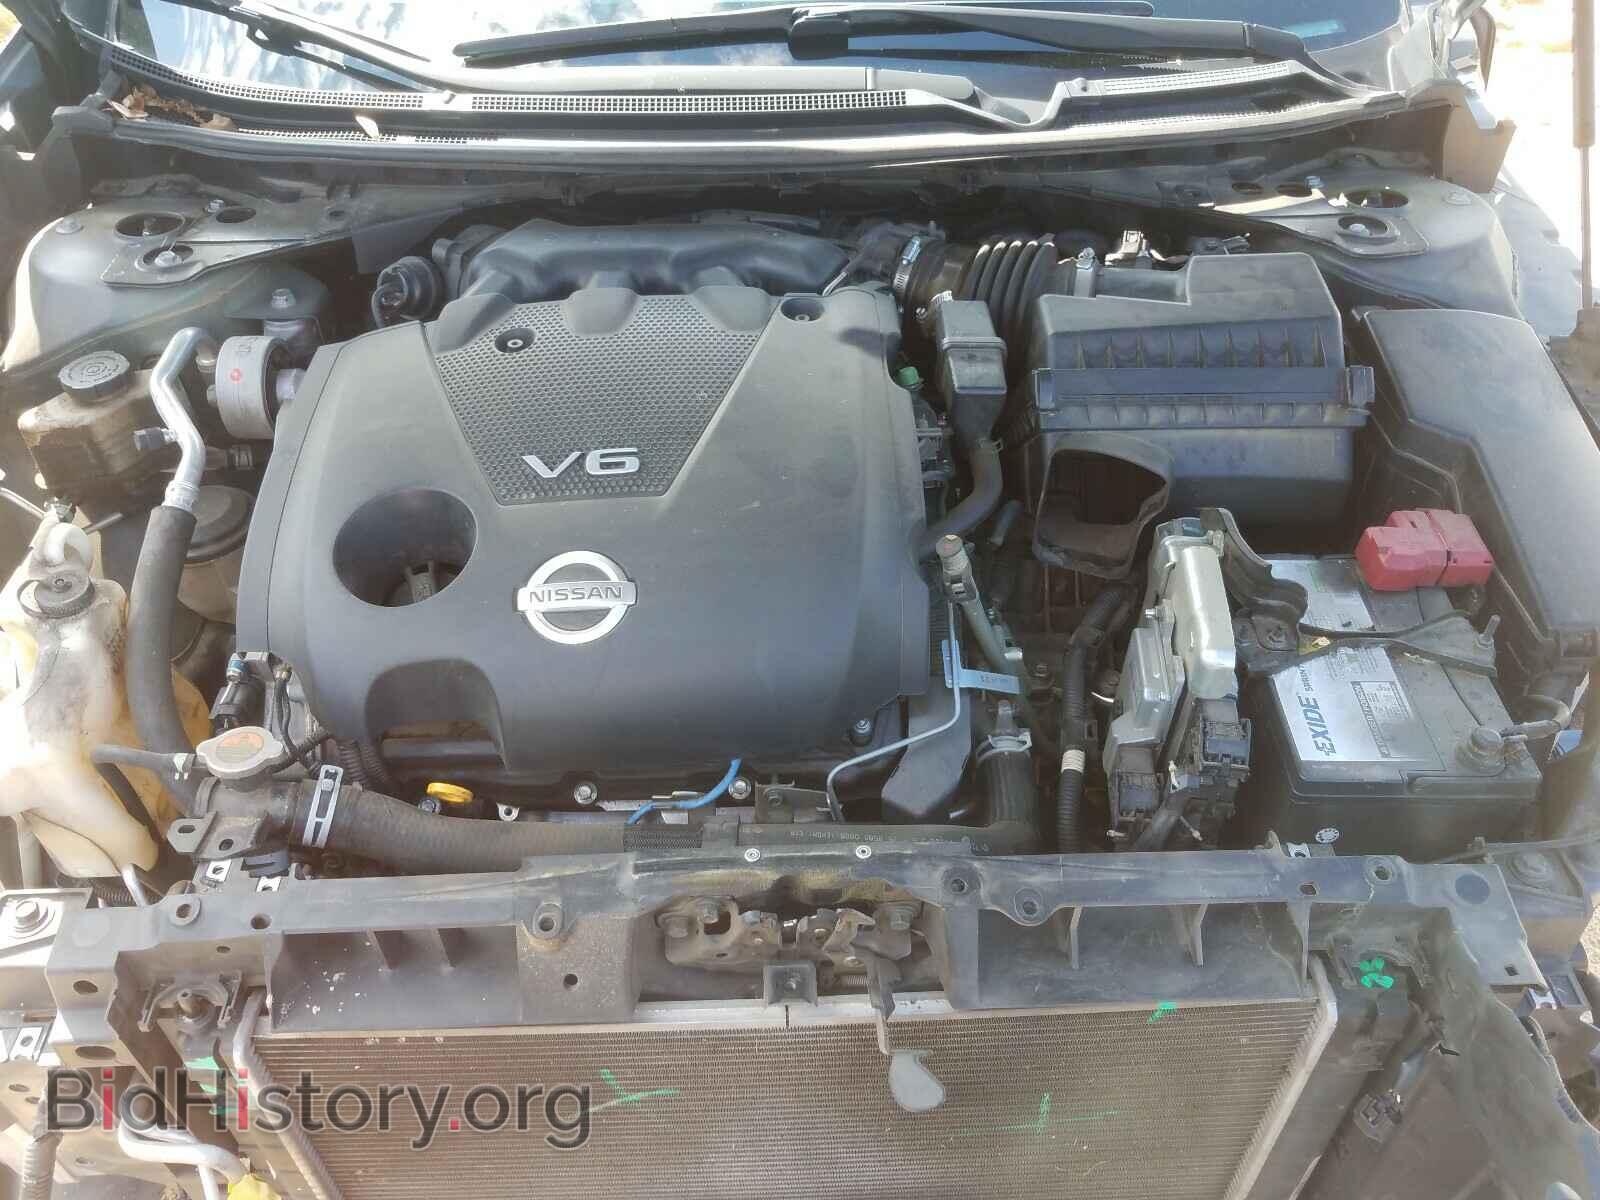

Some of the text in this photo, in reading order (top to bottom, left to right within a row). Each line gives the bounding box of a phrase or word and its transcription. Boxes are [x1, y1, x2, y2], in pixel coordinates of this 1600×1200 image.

[521, 447, 640, 479] V6
[529, 586, 624, 603] NISSAN
[1298, 695, 1337, 756] EXIDE
